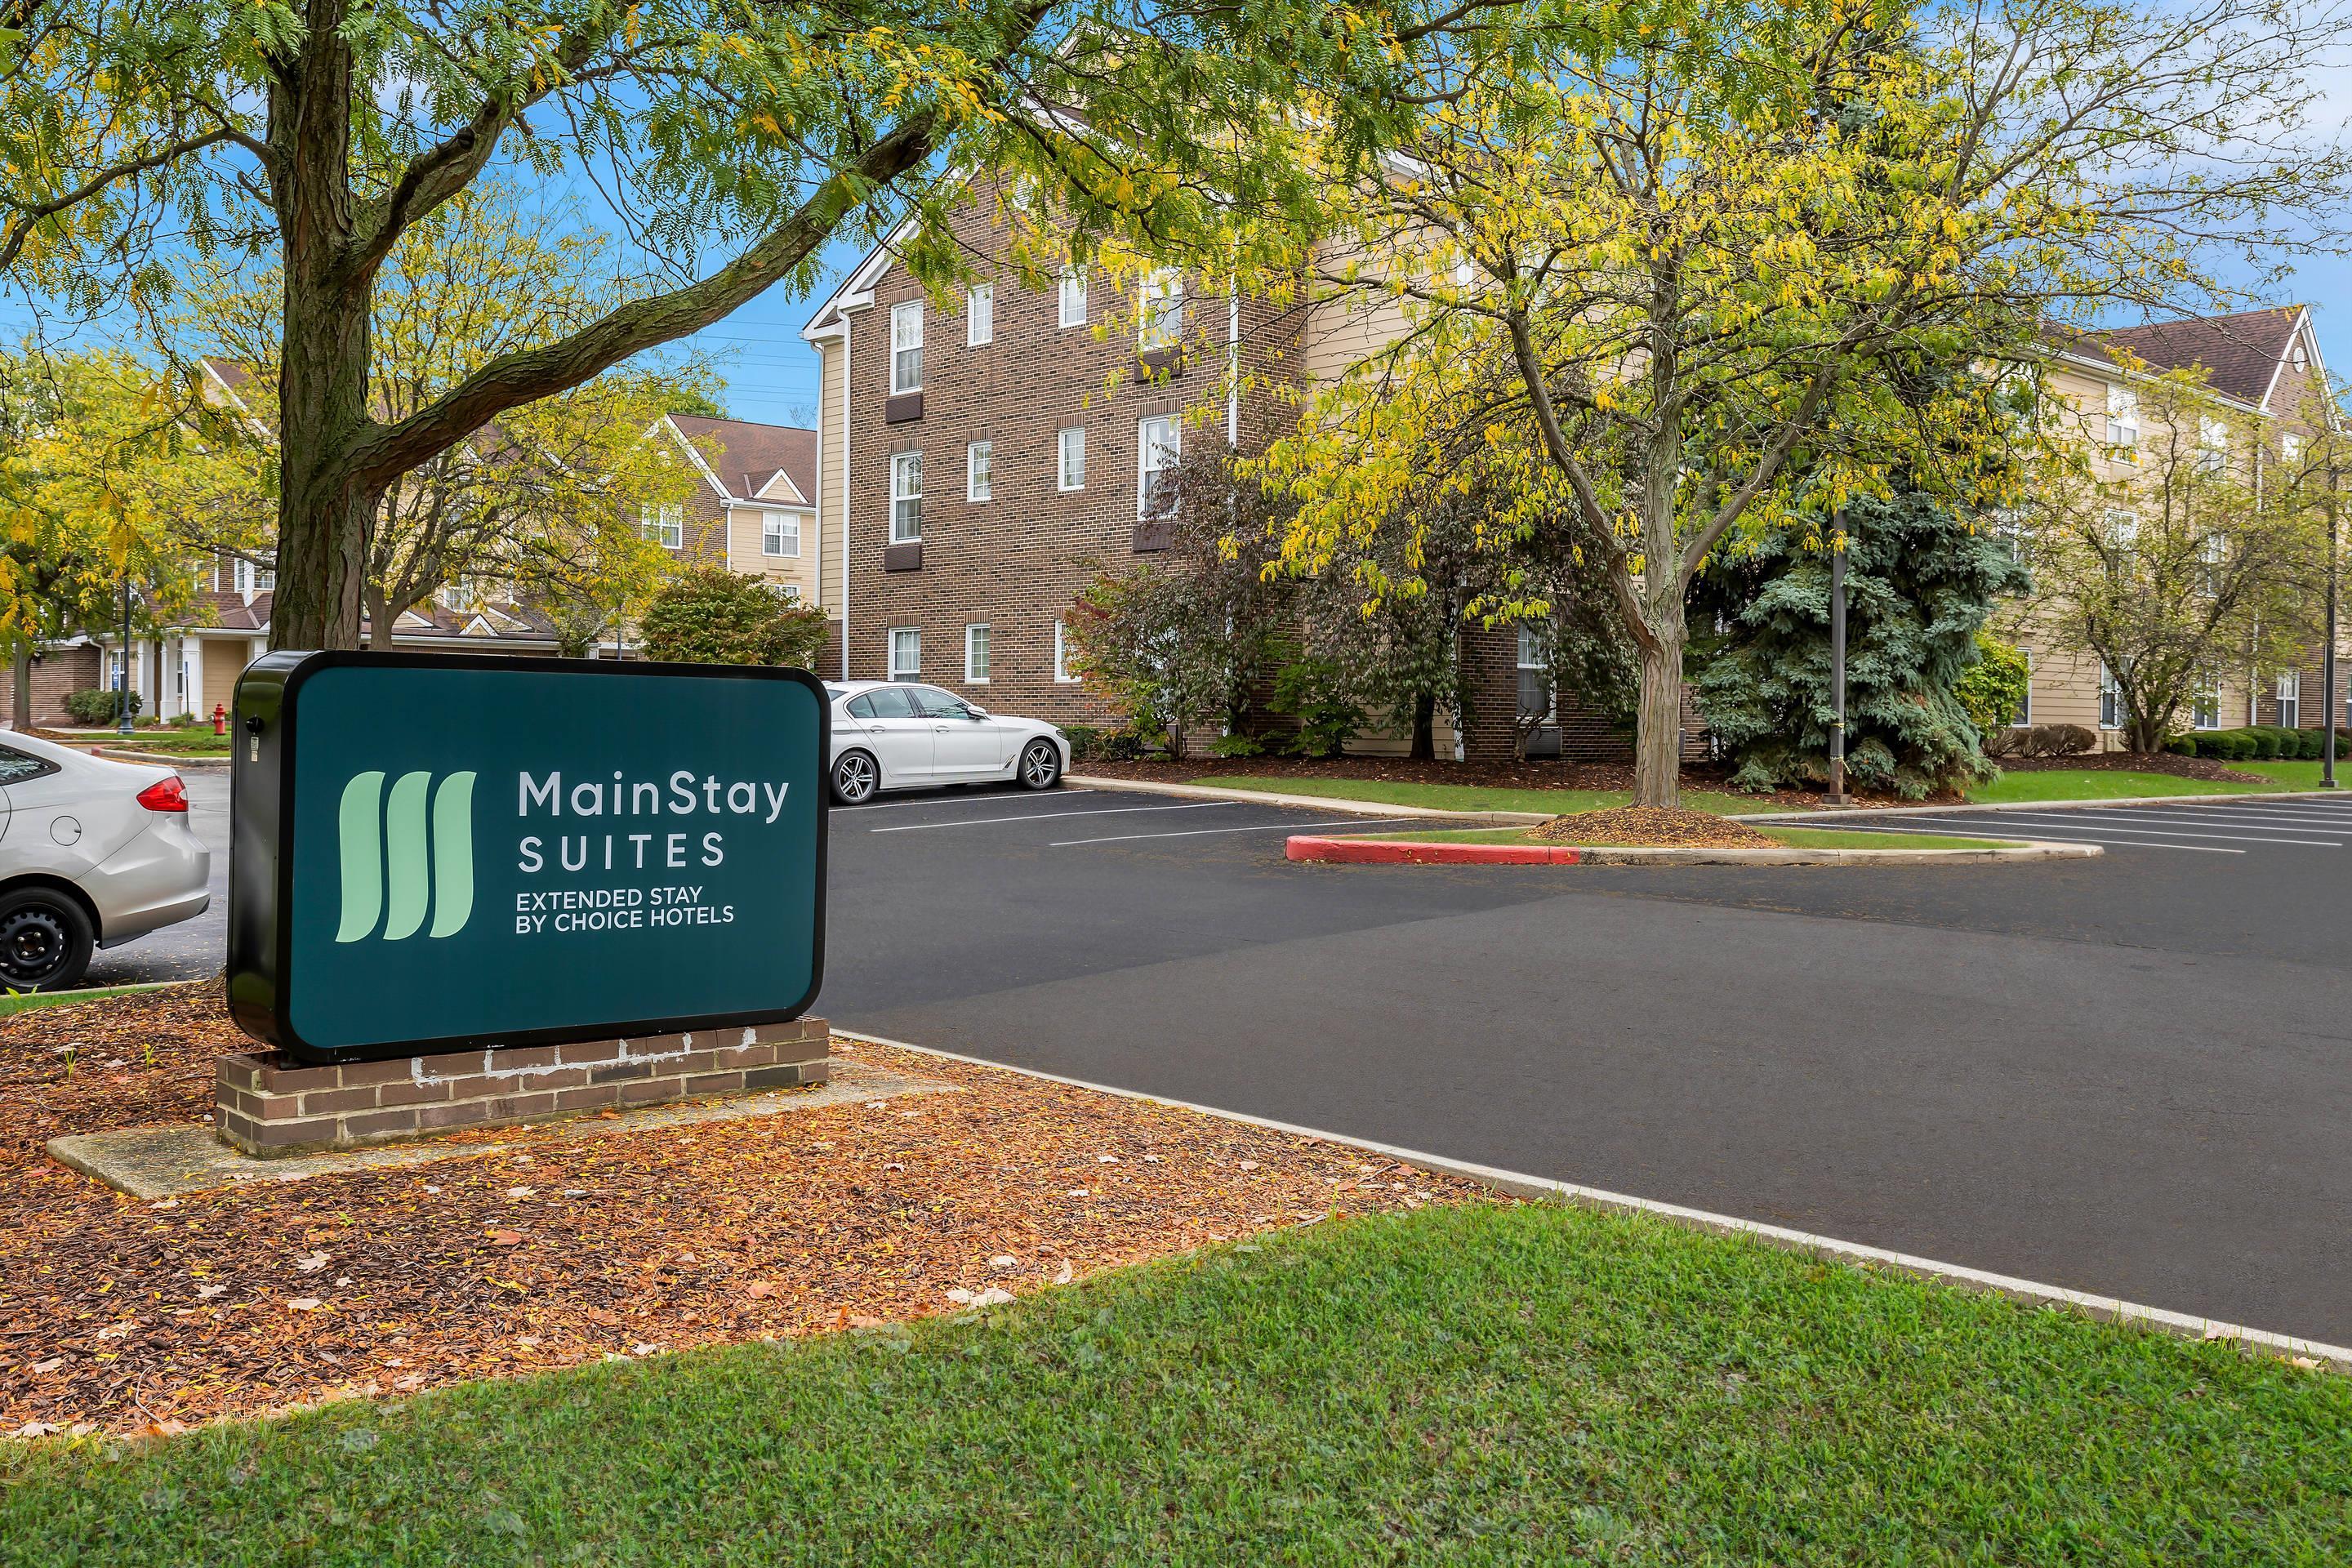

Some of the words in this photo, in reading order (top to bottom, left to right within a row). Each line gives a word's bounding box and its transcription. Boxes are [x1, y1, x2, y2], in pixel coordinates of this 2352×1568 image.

[519, 770, 789, 824] MainStay
[518, 832, 724, 873] SUITES
[516, 888, 642, 911] EXTENDED
[650, 886, 703, 906] STAY
[516, 915, 547, 934] BY
[555, 911, 643, 932] CHOICE
[651, 906, 734, 928] HOTELS
